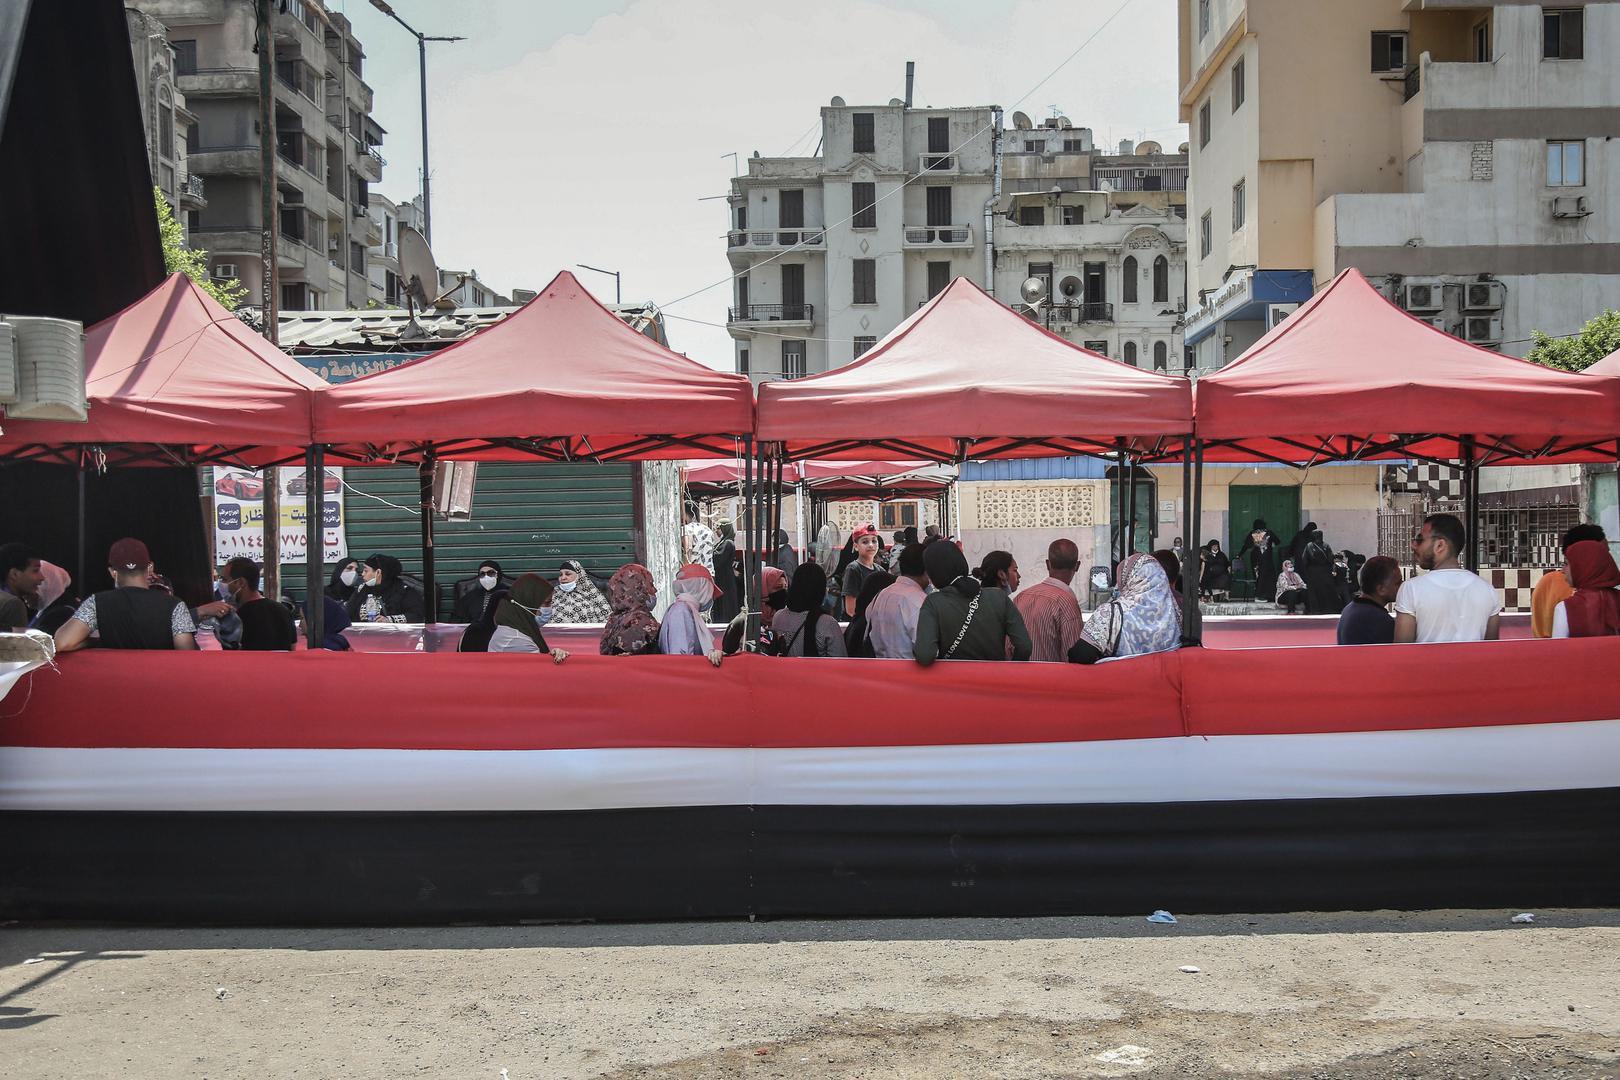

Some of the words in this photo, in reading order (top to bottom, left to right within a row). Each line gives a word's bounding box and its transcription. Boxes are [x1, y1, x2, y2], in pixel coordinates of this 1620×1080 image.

[324, 550, 341, 559] الجرا
[948, 639, 960, 654] LOVE
[957, 624, 969, 640] LOVE
[965, 608, 975, 625] LOVE
